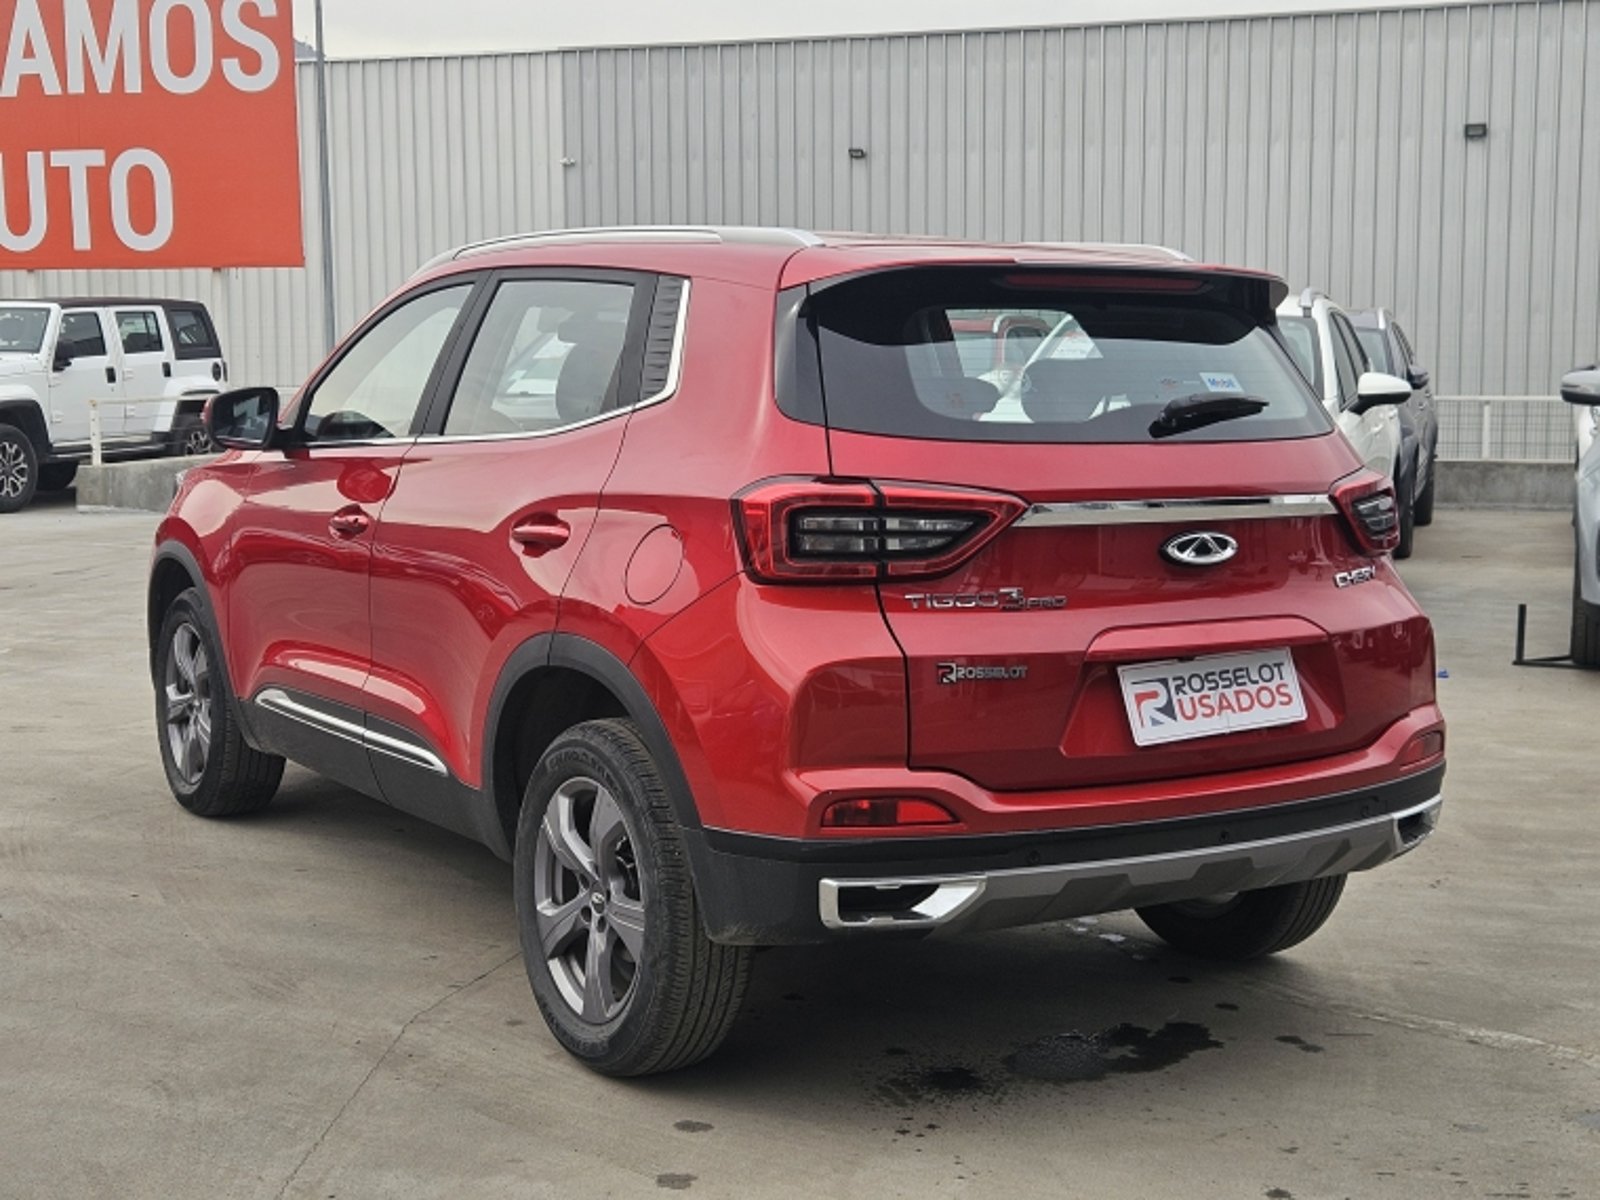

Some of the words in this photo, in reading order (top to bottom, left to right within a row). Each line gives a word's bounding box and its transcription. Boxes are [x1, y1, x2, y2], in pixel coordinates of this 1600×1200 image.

[1334, 565, 1376, 588] CHERY
[904, 592, 998, 611] TIGGO
[1171, 662, 1285, 696] ROSSELOT
[1175, 683, 1294, 721] USADOS
